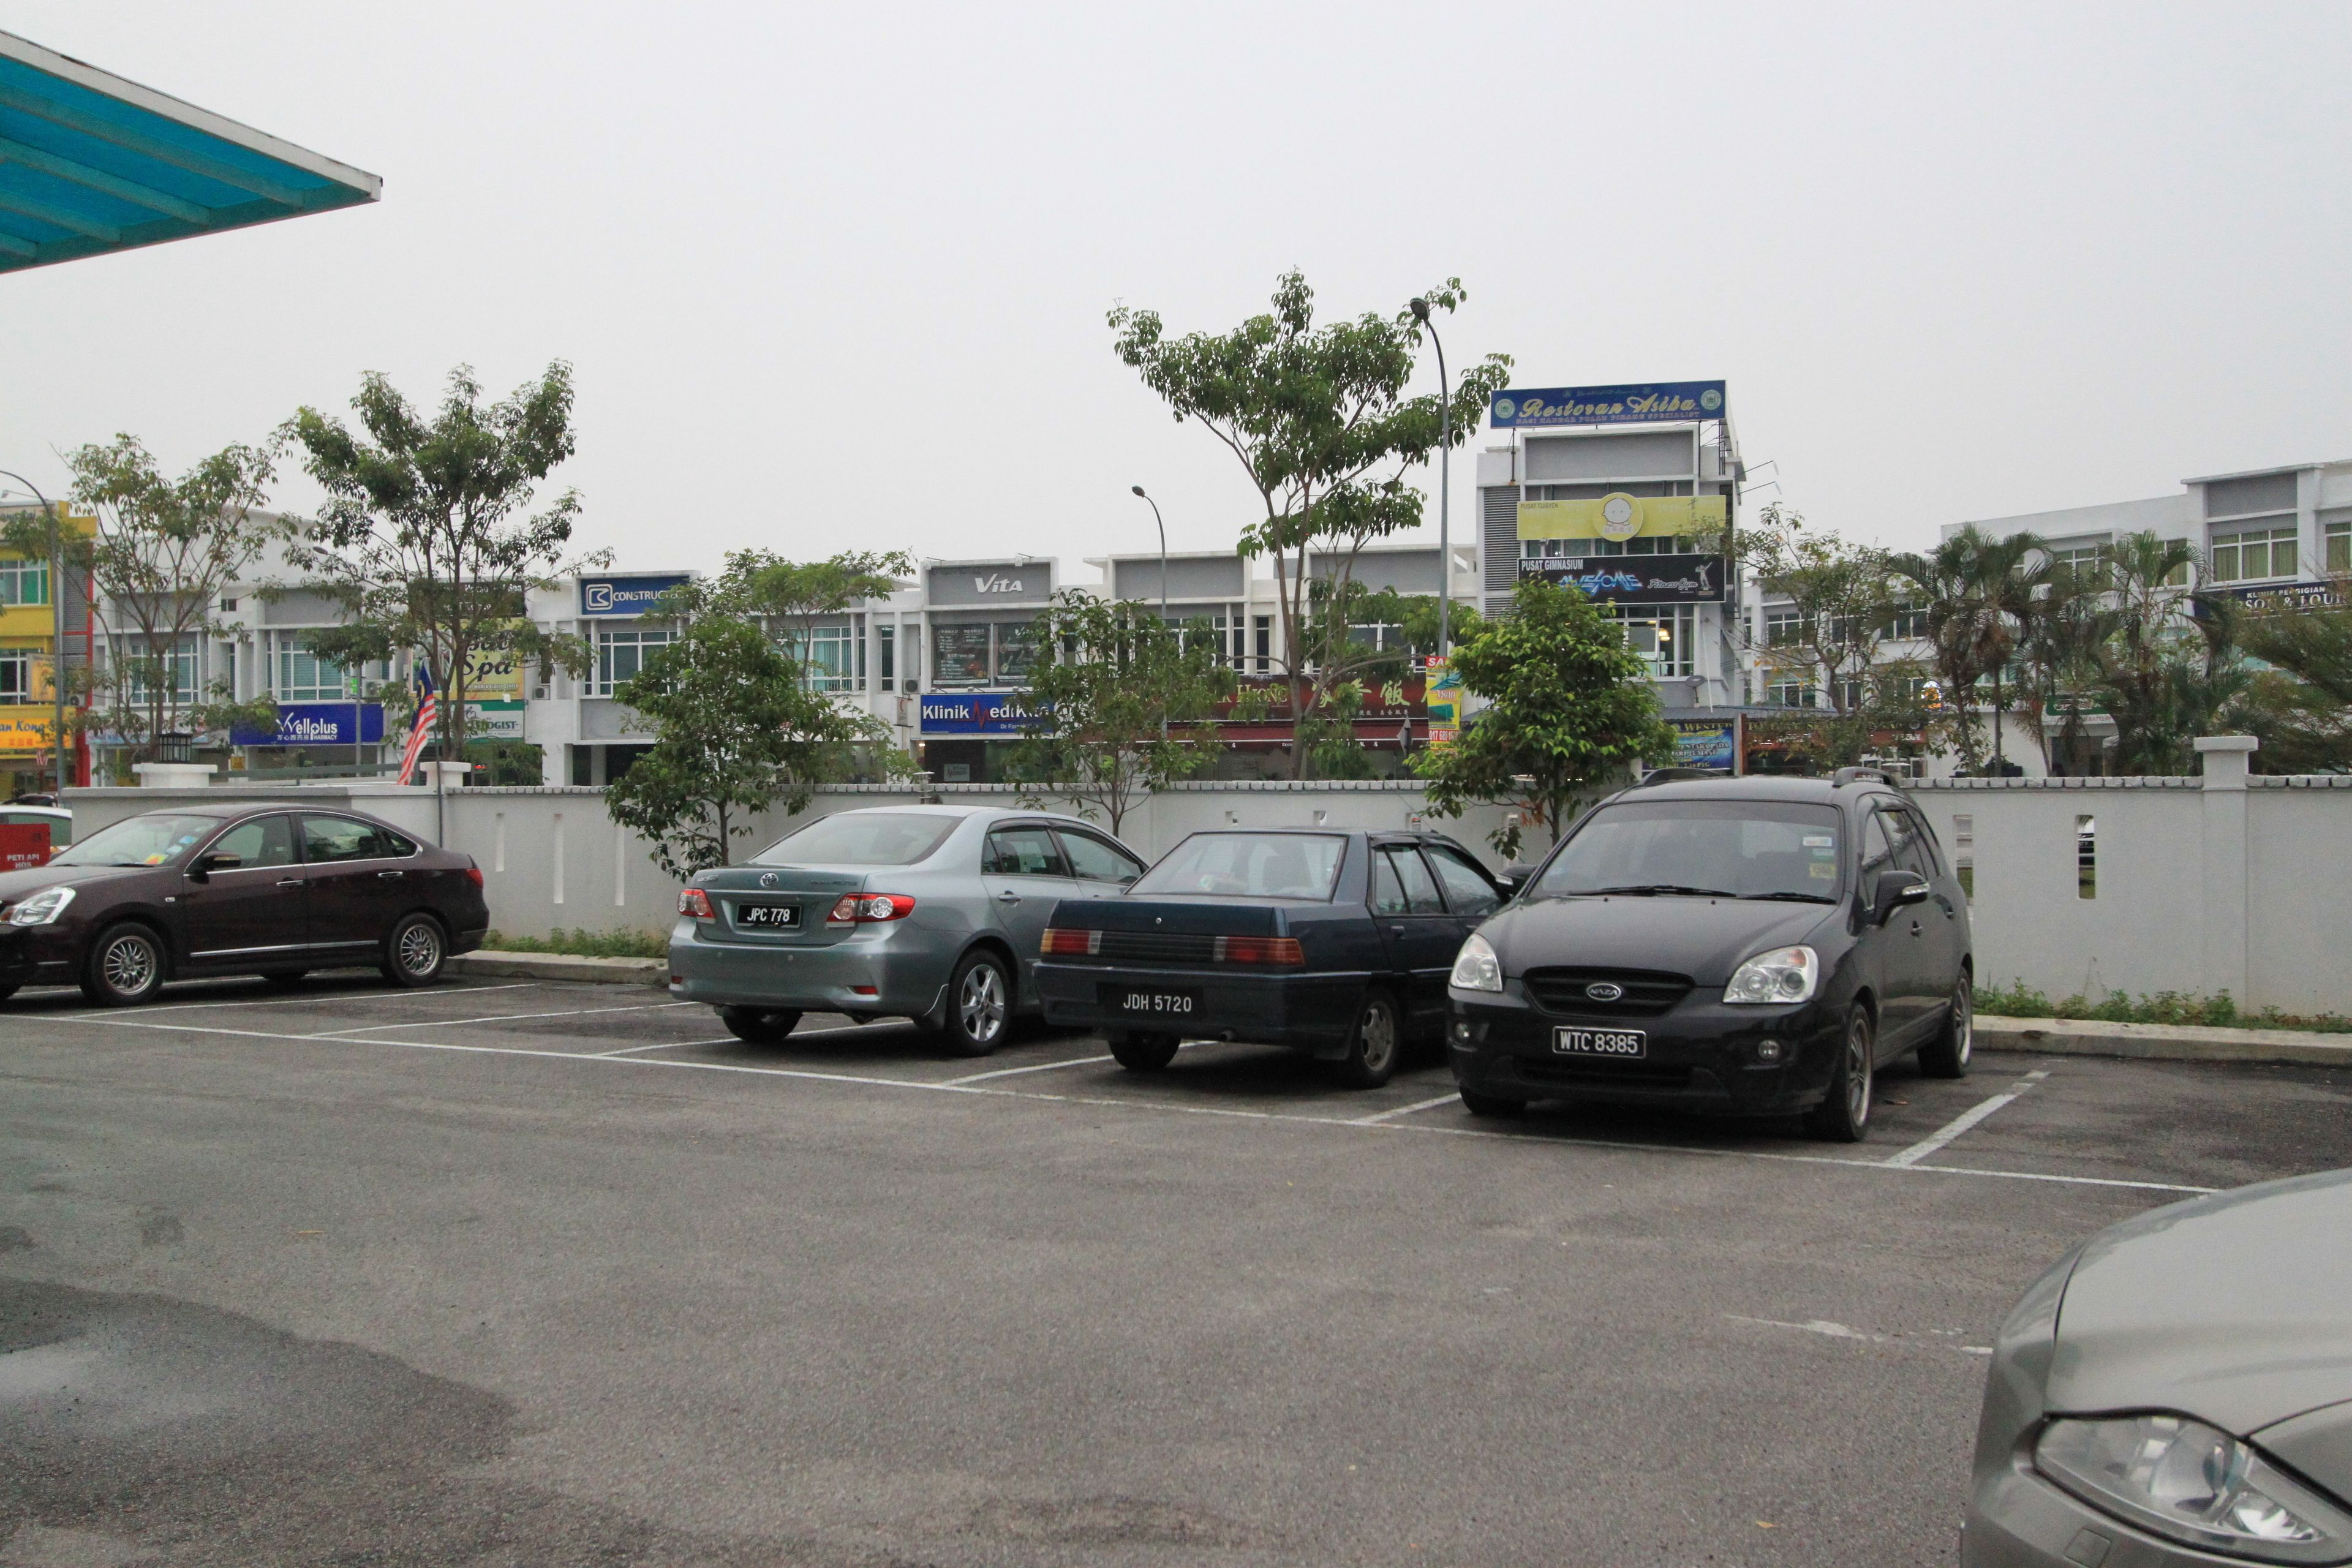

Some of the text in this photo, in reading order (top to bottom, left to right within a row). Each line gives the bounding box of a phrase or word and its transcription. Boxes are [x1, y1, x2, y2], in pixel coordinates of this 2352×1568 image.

[1519, 393, 1696, 418] Restoran Asiba
[1521, 559, 1583, 571] PUSAT GIMNASIUM
[1647, 578, 1699, 590] Fitness Gym
[922, 705, 970, 720] Klinik
[276, 712, 337, 740] Wellplus
[747, 908, 791, 922] JPC 778
[1123, 993, 1192, 1012] JDH 5720
[1560, 1031, 1638, 1054] WTC 8385
